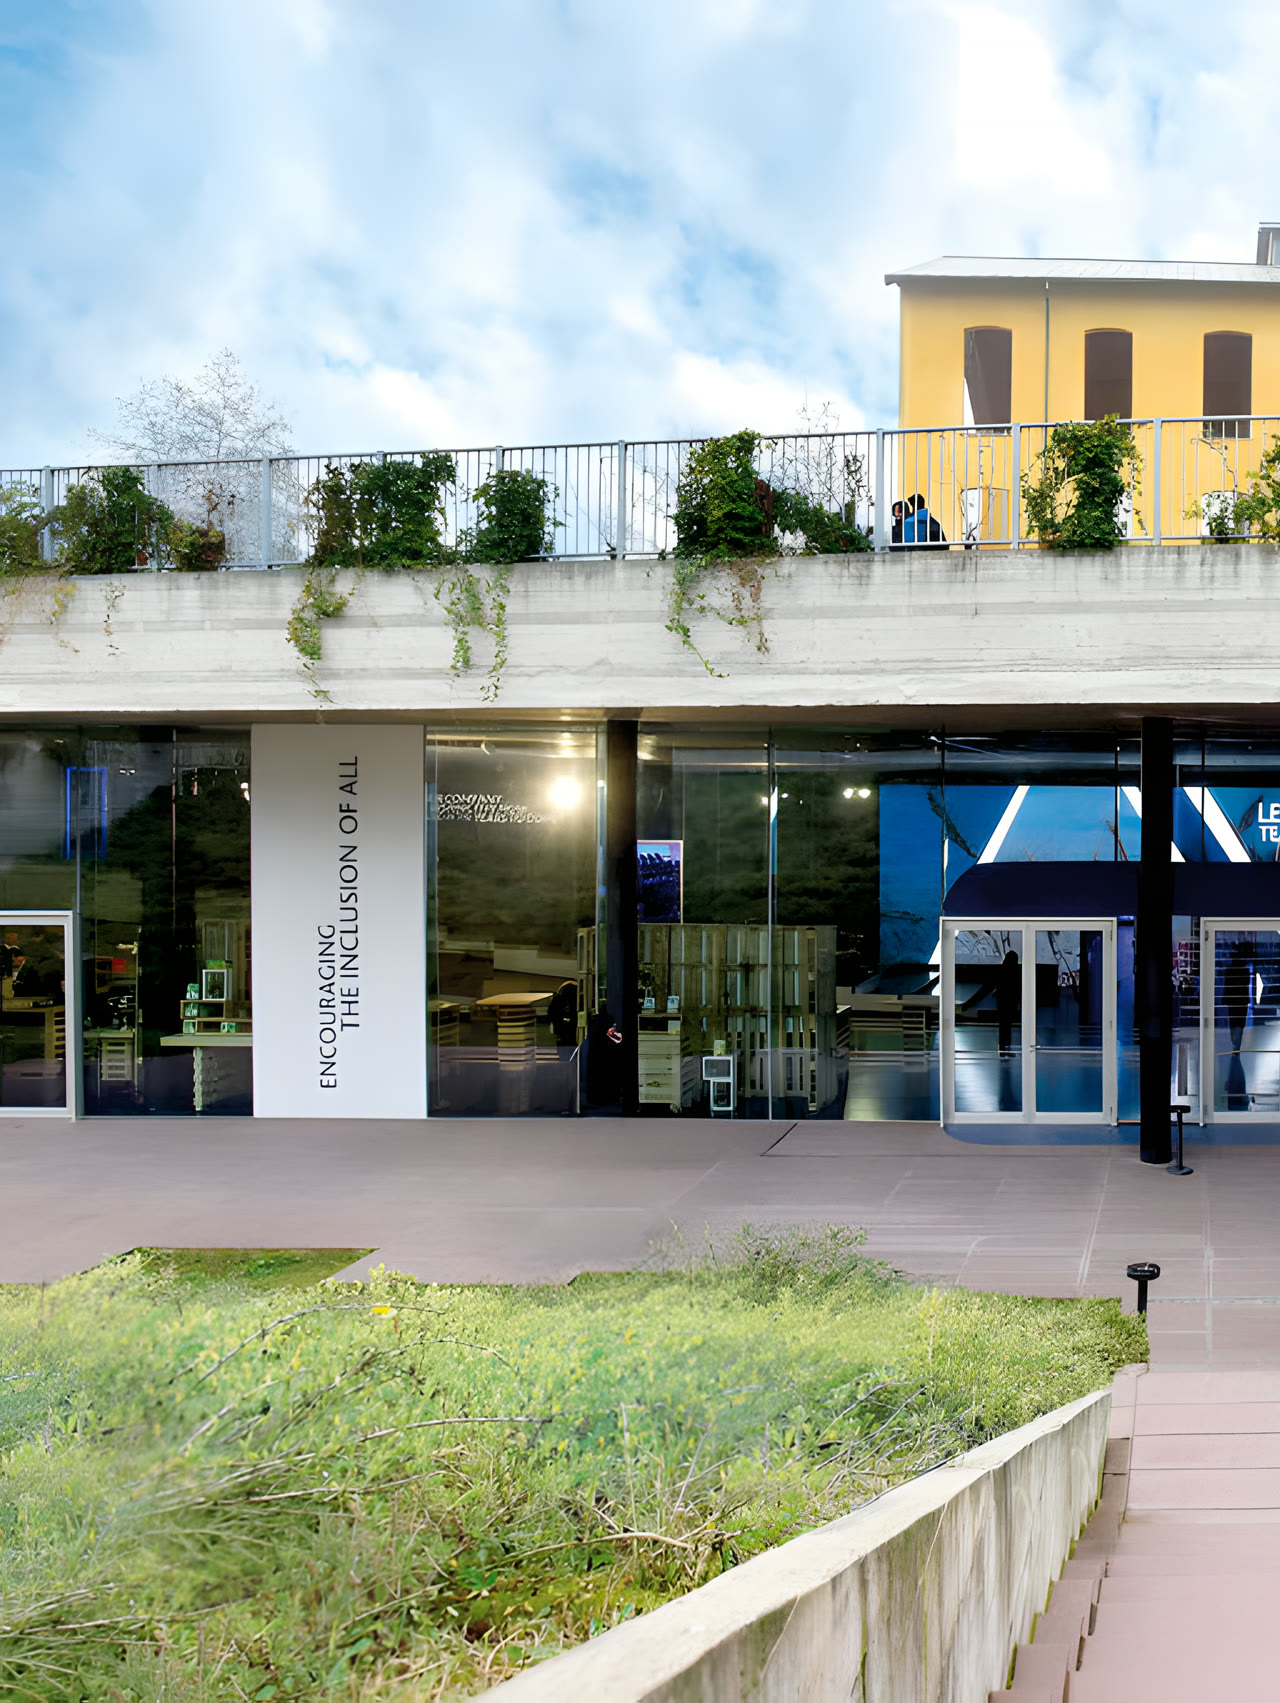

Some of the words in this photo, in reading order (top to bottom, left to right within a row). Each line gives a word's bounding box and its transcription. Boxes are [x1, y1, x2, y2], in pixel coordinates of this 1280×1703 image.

[339, 756, 358, 795] ALL
[339, 803, 358, 834] OF
[339, 845, 359, 978] INCLUSION
[318, 924, 337, 1088] ENCOURAGING
[340, 987, 360, 1032] THE
